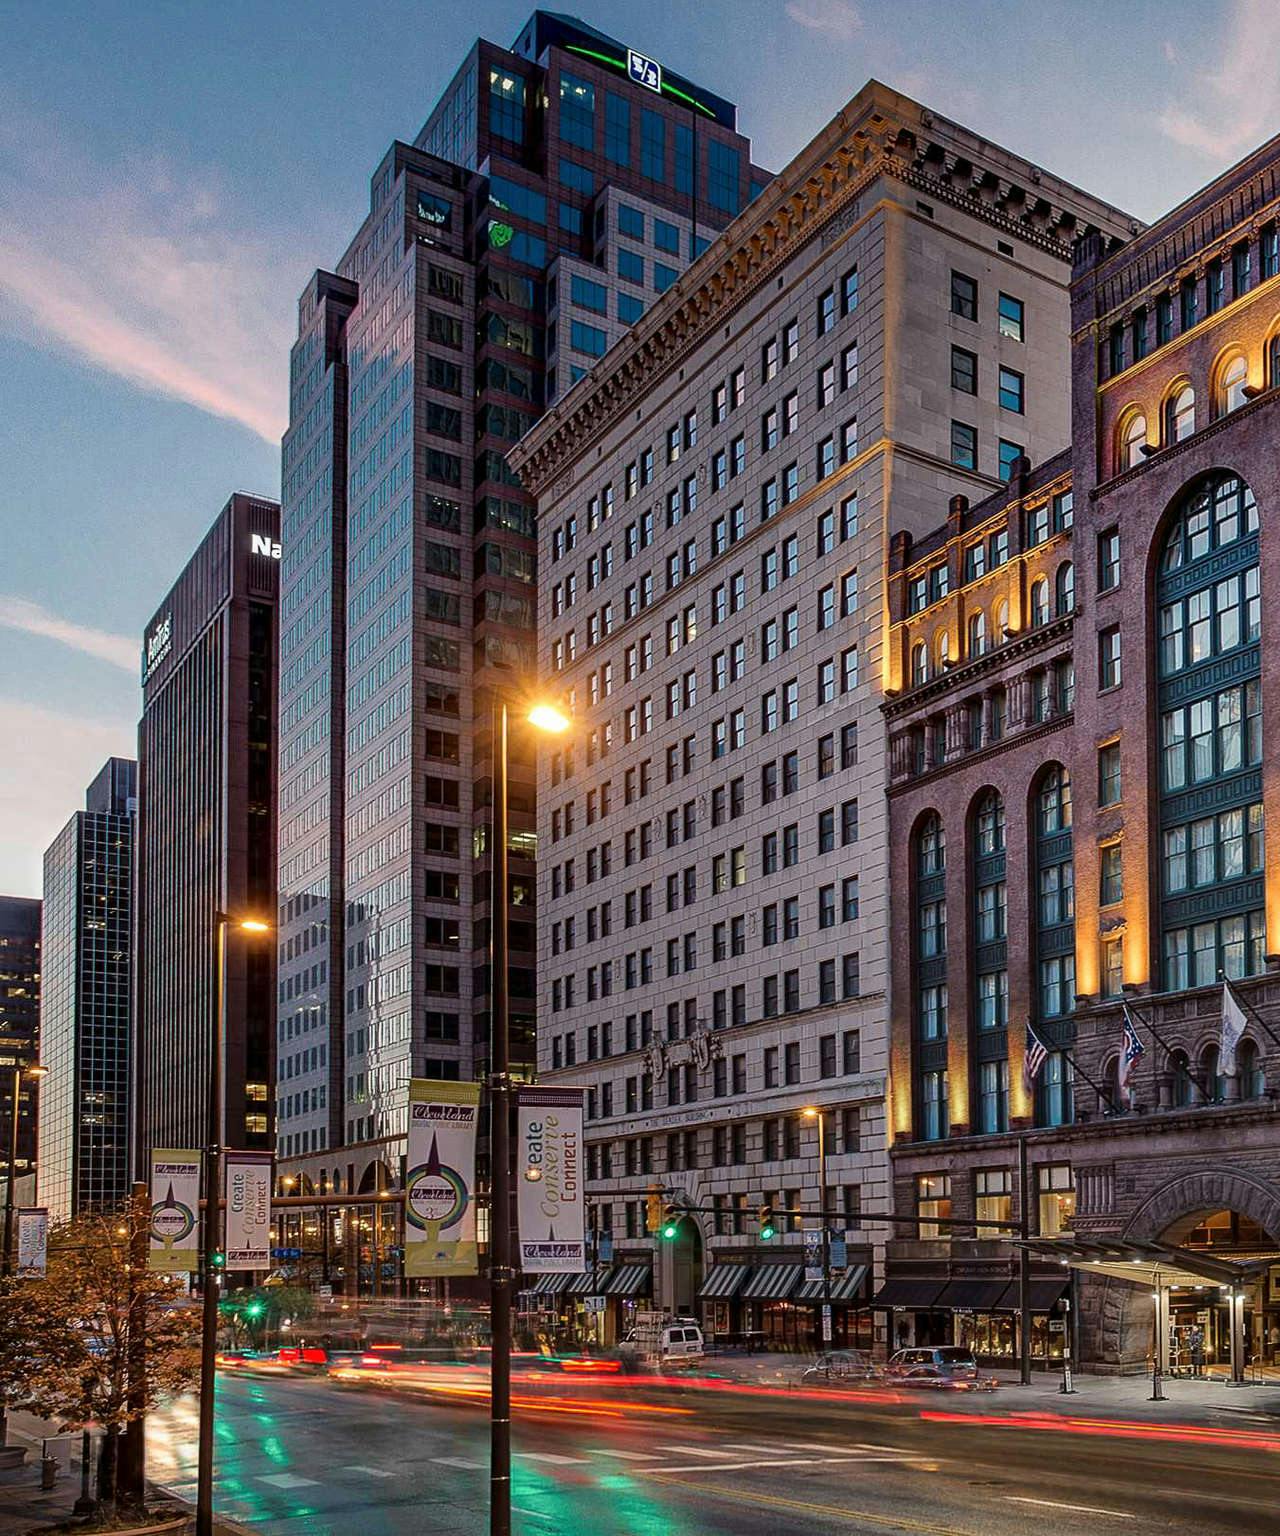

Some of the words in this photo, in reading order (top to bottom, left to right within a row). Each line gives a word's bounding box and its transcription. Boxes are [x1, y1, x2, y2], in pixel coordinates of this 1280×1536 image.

[231, 1174, 245, 1213] Create
[540, 1114, 559, 1218] Conserve
[560, 1132, 577, 1202] Connect
[255, 1180, 267, 1225] Connect
